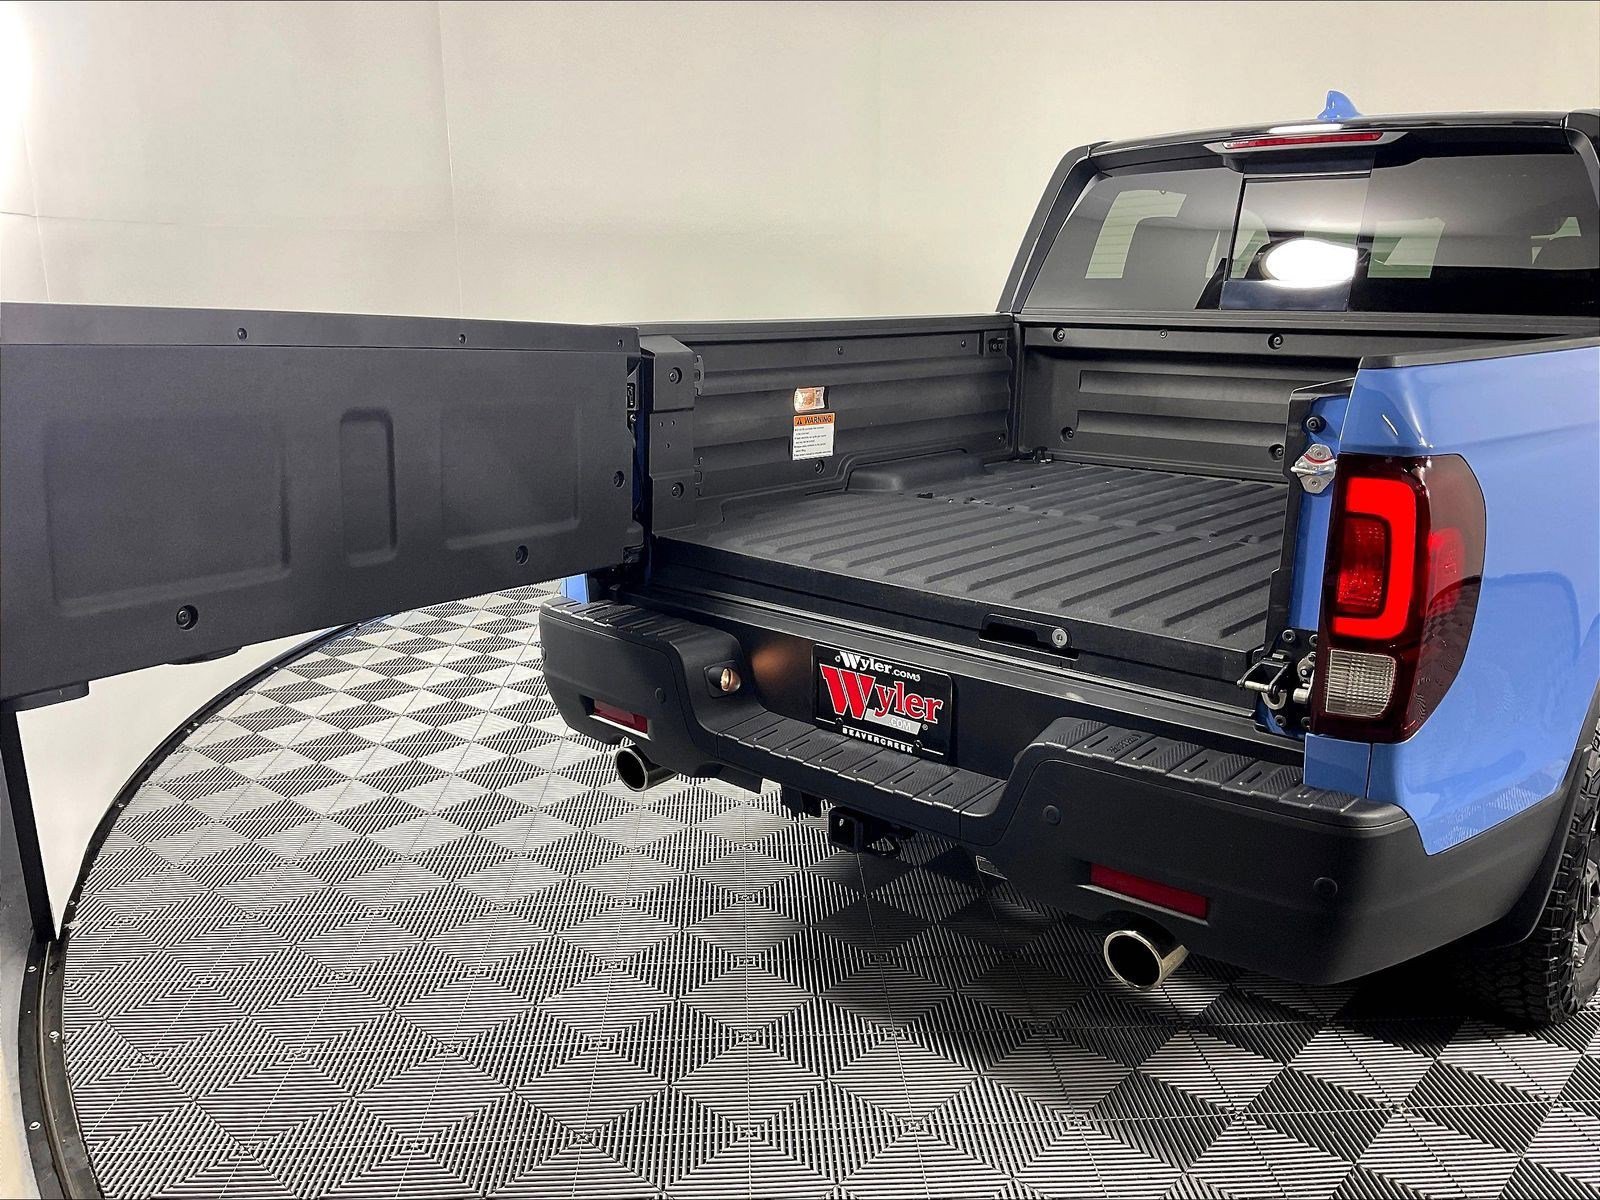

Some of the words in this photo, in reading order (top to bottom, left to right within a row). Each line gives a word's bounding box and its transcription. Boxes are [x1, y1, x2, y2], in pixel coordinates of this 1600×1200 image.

[805, 415, 832, 424] WARNING
[819, 663, 943, 724] Wyler
[842, 727, 913, 753] BEAVERCREEK
